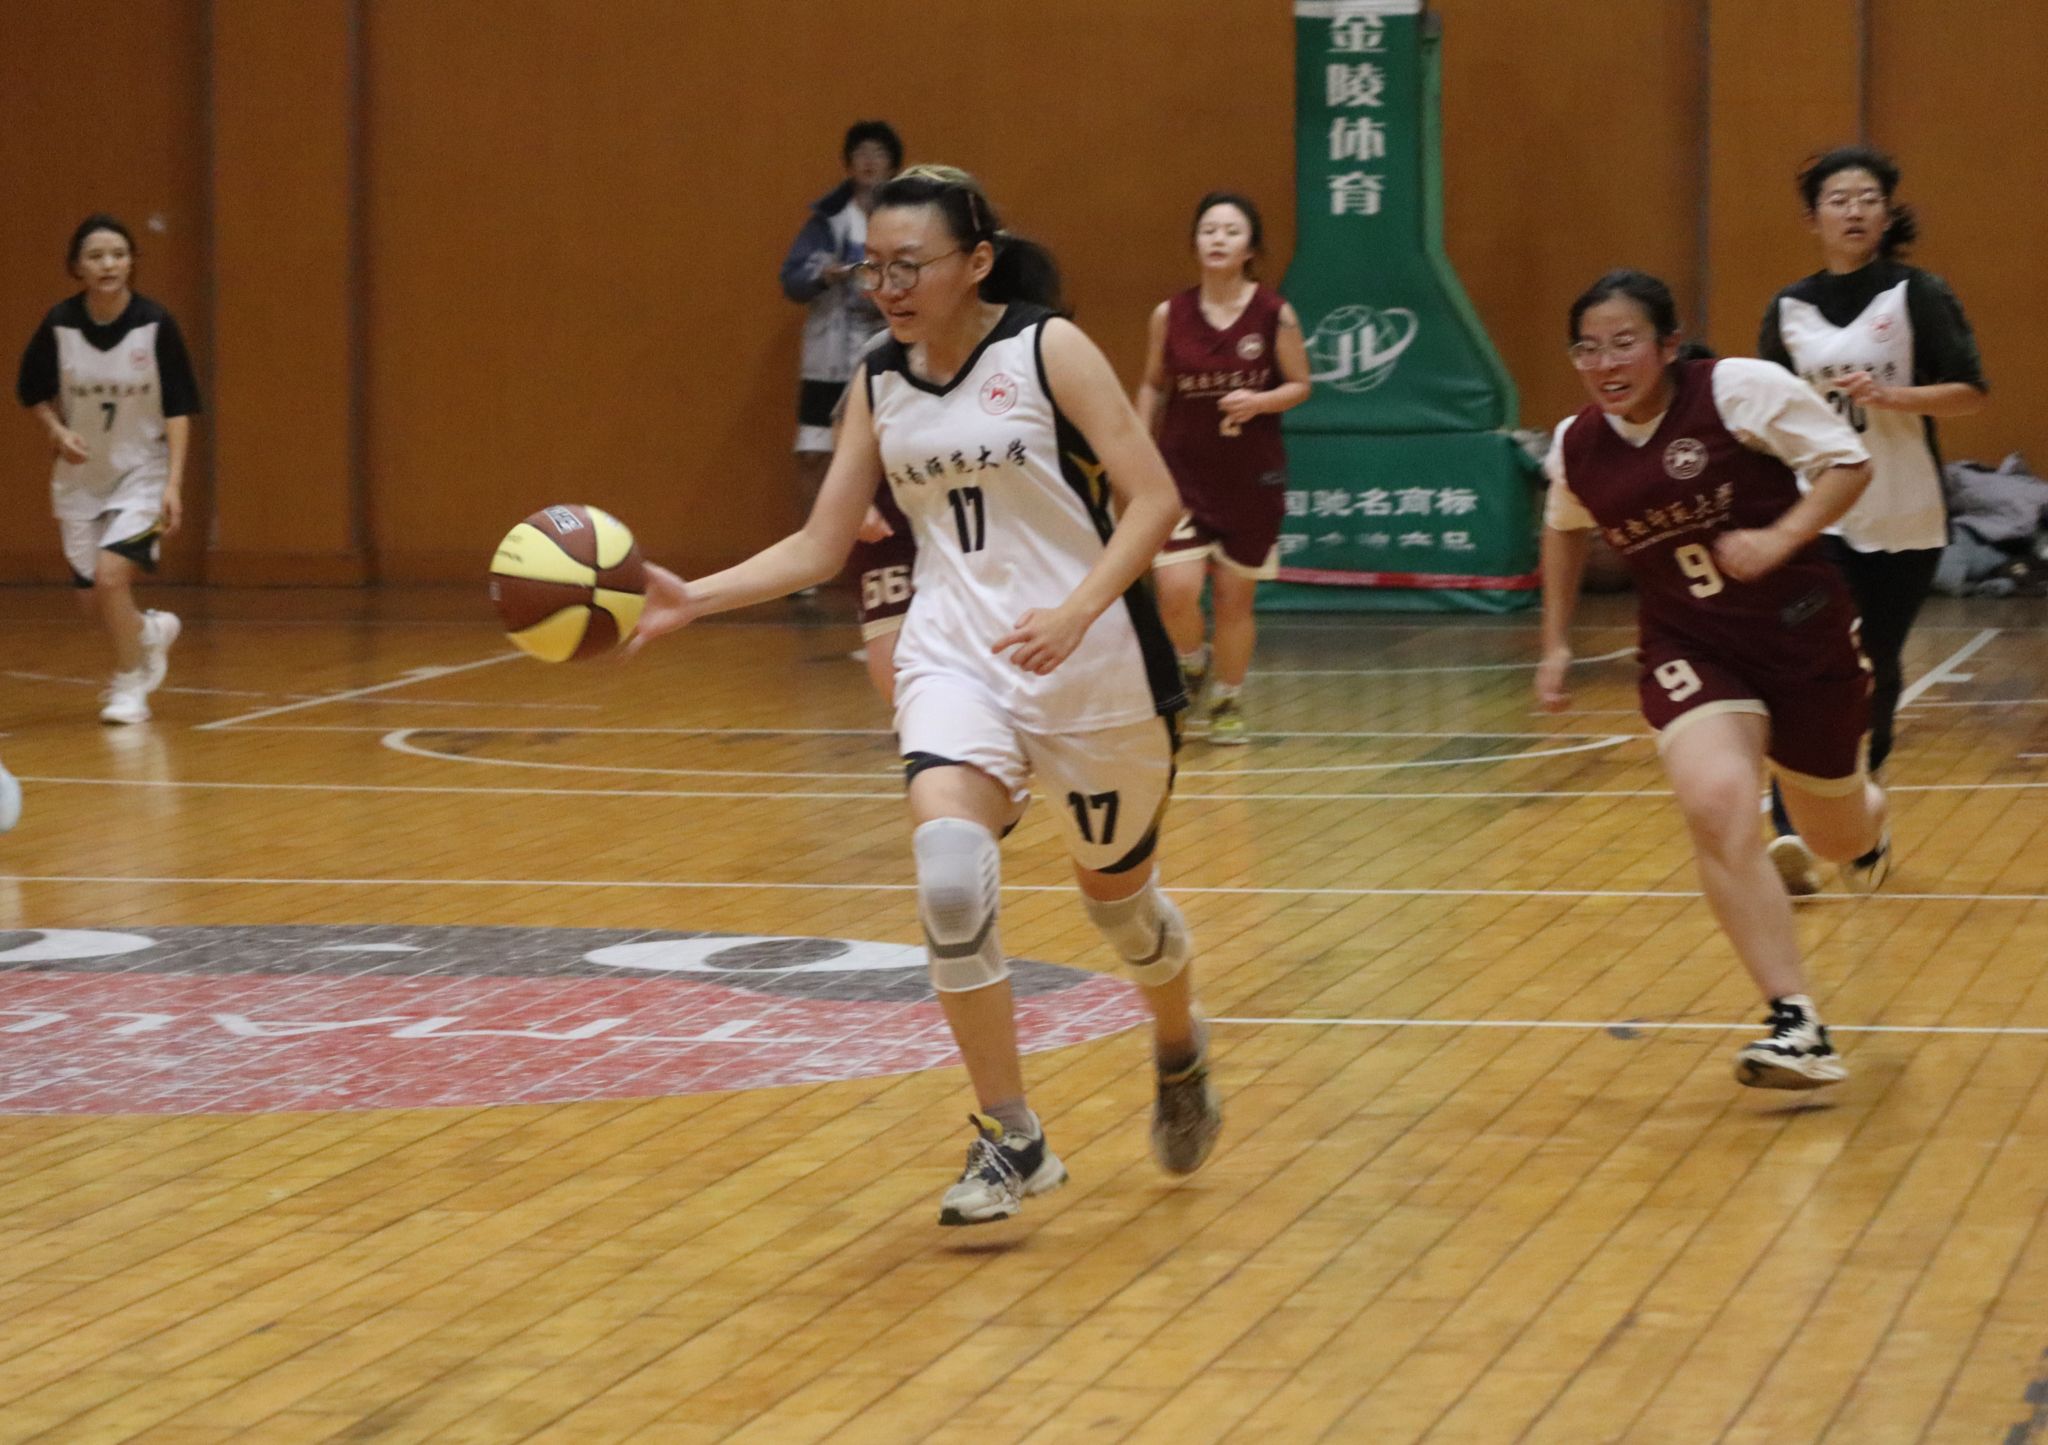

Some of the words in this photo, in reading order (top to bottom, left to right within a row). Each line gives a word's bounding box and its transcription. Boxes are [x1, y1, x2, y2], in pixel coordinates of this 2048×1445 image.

[1326, 13, 1386, 215] 金陵体育
[100, 402, 117, 432] 7
[948, 486, 985, 554] 17
[1675, 543, 1724, 599] 9
[1653, 658, 1704, 702] 9
[1067, 790, 1119, 844] 17
